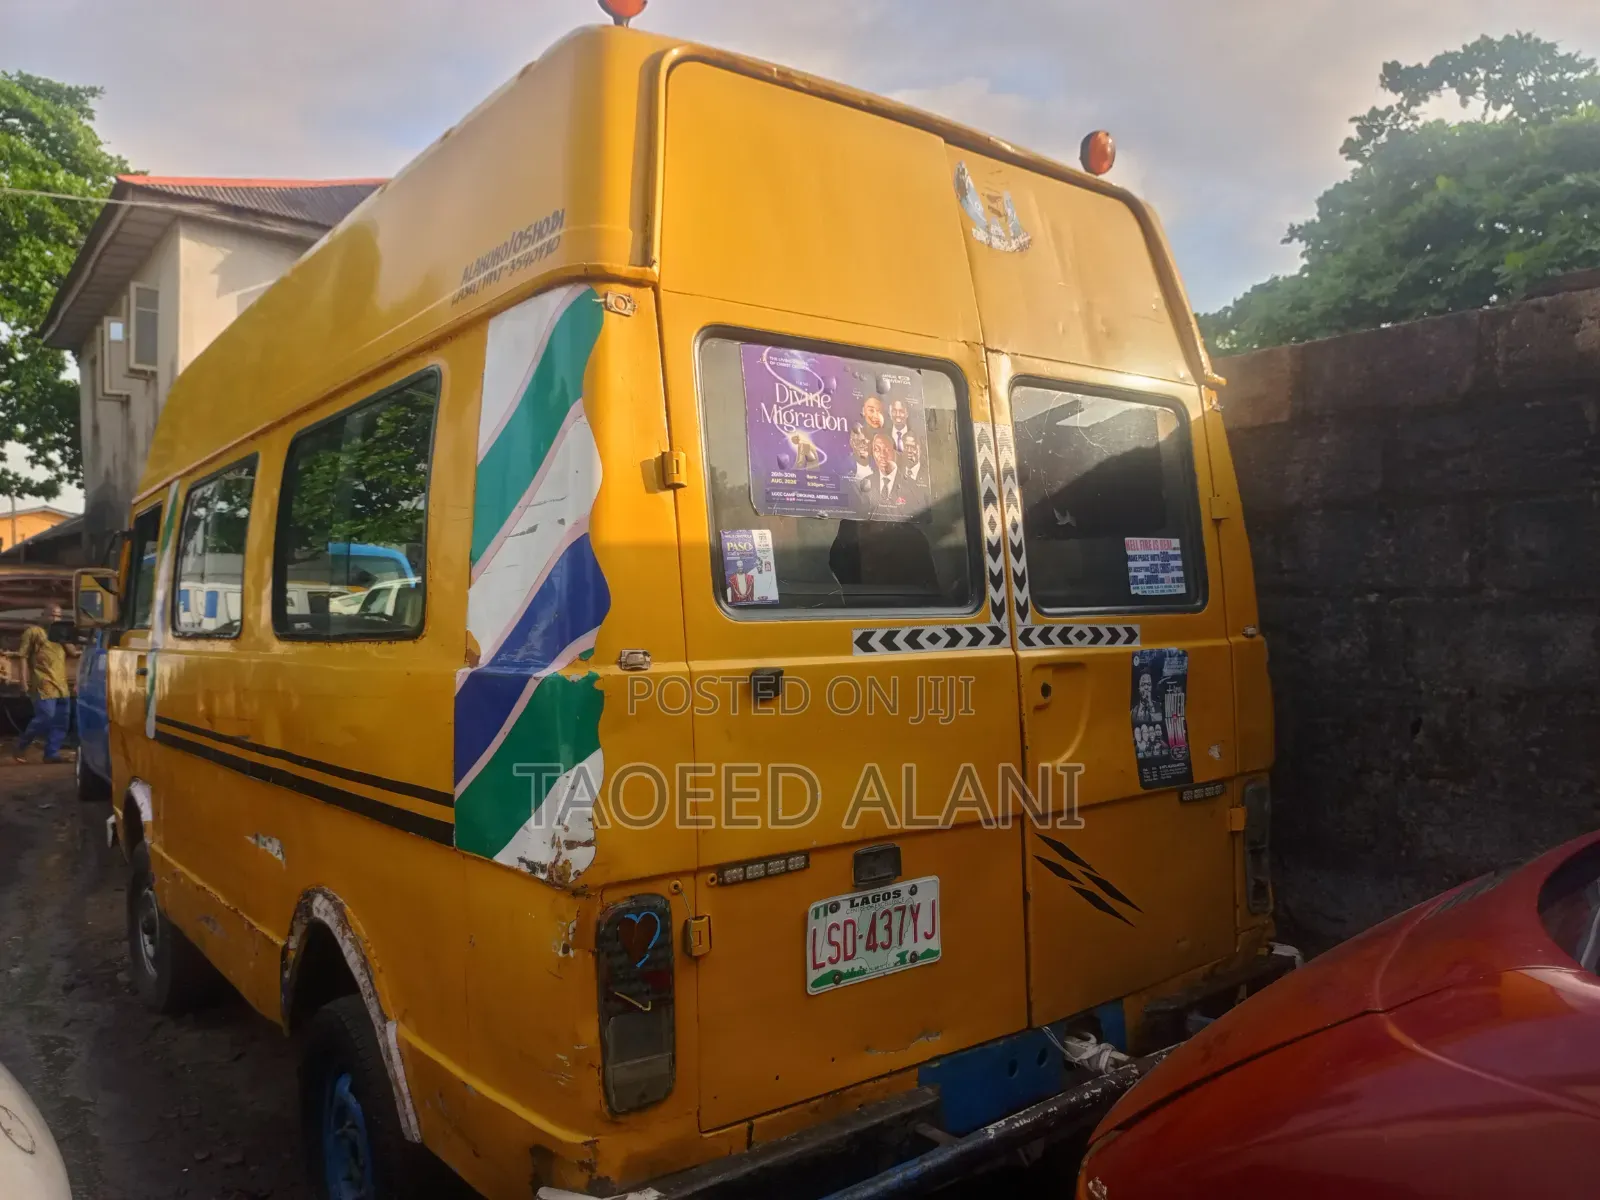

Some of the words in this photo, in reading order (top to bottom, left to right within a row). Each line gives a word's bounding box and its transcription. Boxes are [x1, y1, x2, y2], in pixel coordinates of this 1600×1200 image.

[775, 382, 832, 410] Divine
[761, 402, 849, 433] Migration
[849, 889, 902, 909] LAGOS
